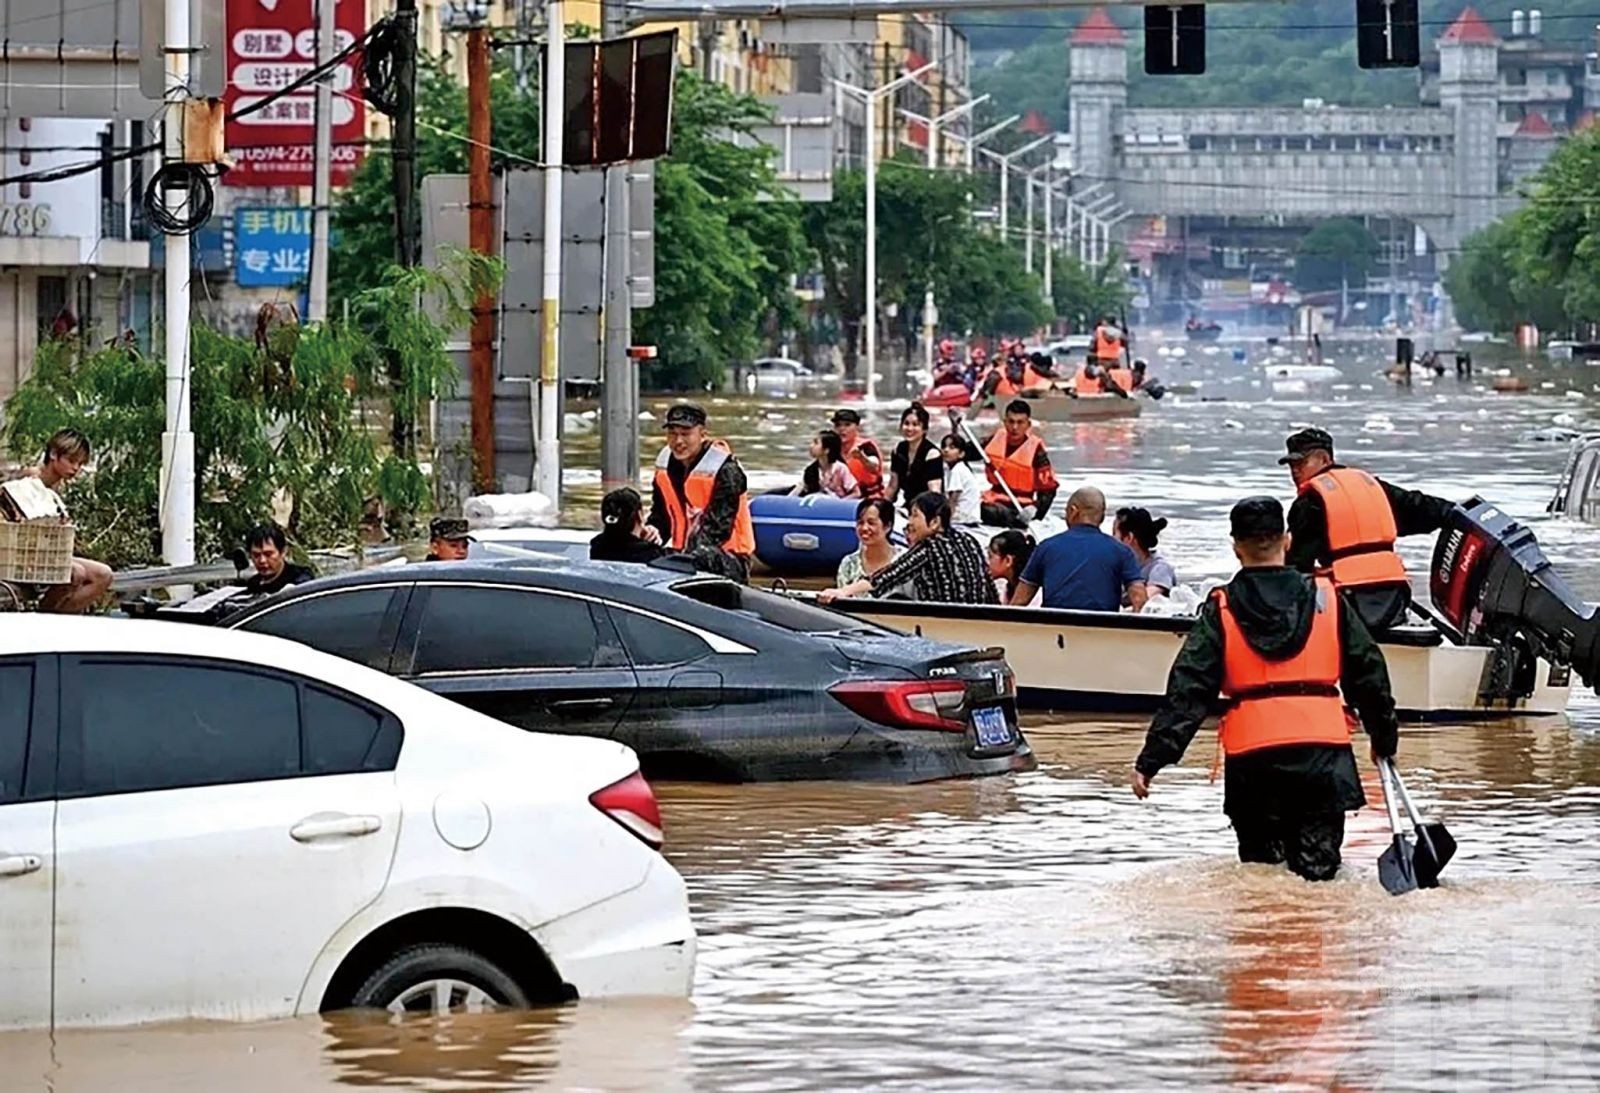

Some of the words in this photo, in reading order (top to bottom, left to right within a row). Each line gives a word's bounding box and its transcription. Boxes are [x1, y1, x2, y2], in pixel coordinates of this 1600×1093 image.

[244, 33, 282, 53] 别墅
[241, 211, 311, 235] 手机
[241, 248, 310, 274] 专业
[1442, 529, 1464, 571] YAMAHA
